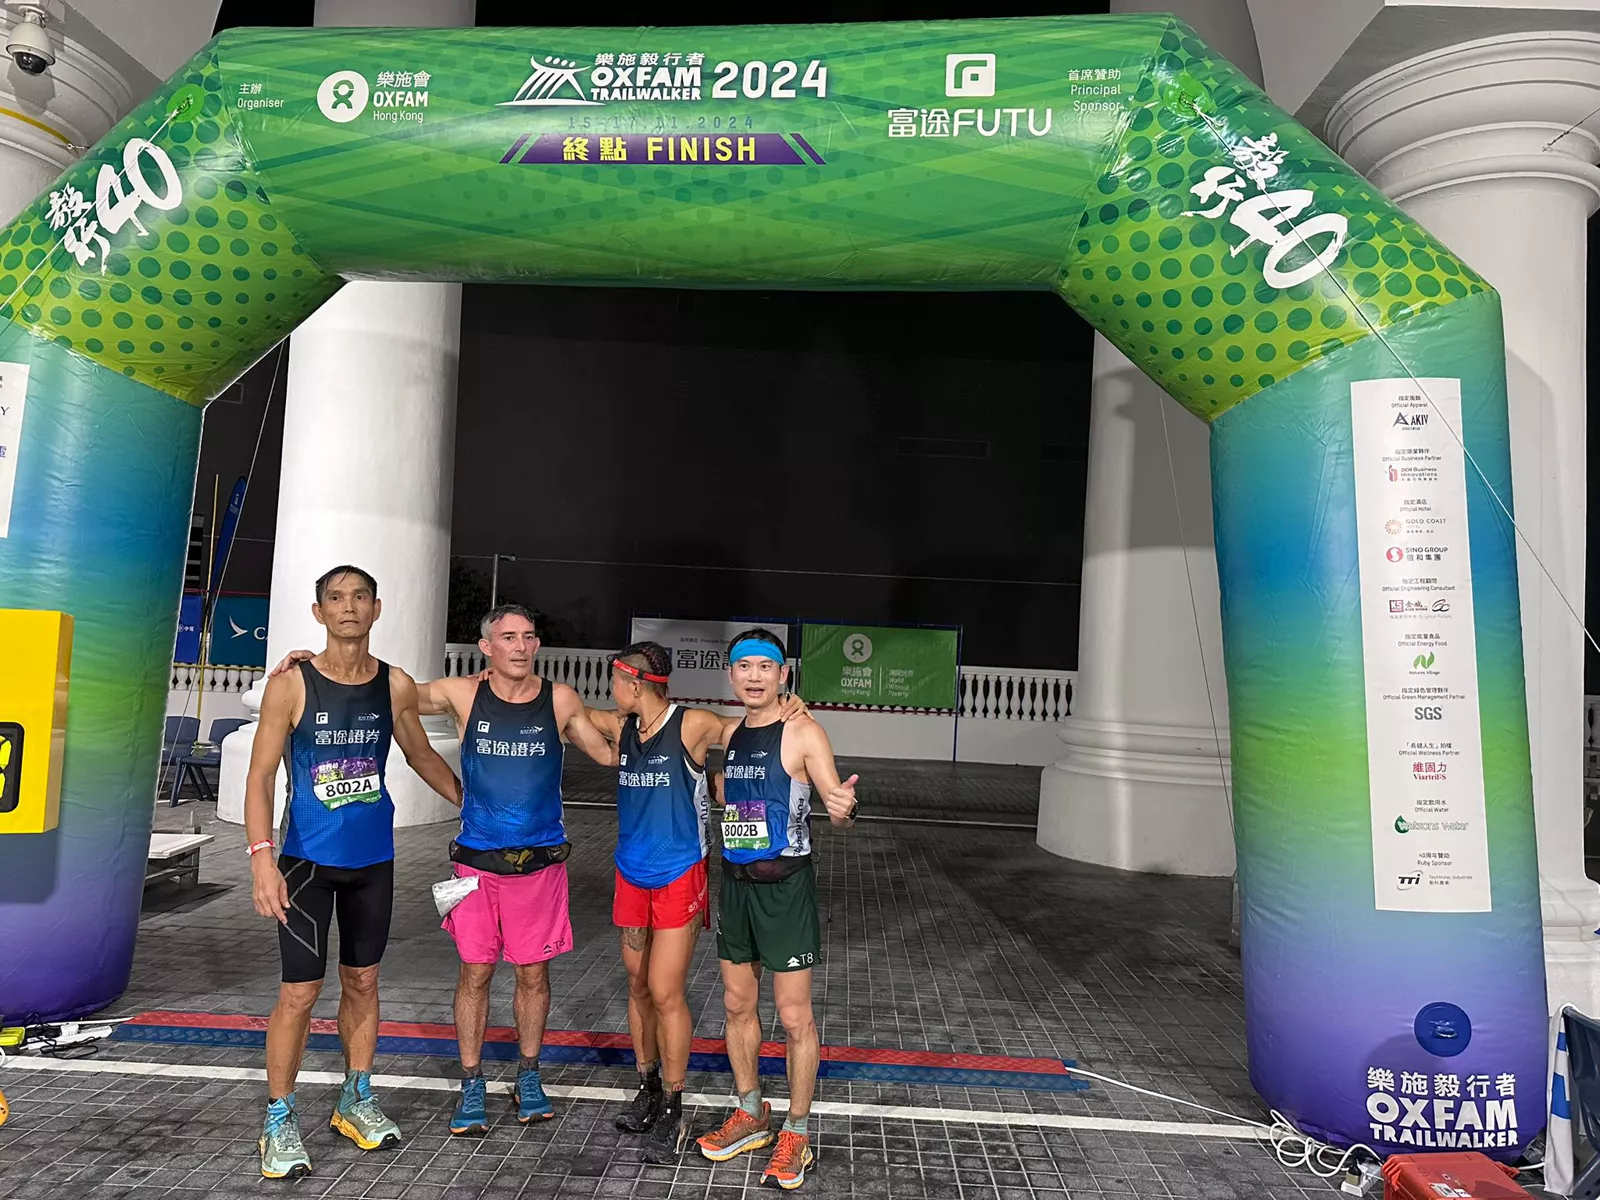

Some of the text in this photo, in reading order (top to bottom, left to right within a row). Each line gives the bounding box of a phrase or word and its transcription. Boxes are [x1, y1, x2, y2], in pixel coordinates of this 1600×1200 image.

[595, 53, 705, 66] 樂施毅行者
[376, 70, 431, 88] 樂施會
[590, 67, 702, 87] OXFAM
[711, 60, 828, 99] 2024
[1067, 68, 1121, 81] 首席贊助
[239, 83, 262, 95] 主辦
[590, 88, 702, 101] TRAILWALKER
[1070, 84, 1121, 96] Principal
[237, 97, 284, 111] Organiser
[373, 91, 428, 107] OXFAM
[1073, 100, 1121, 113] Sponsor
[373, 110, 424, 123] Hong Kong
[562, 137, 755, 161] 終點 FINISH
[95, 137, 183, 235] 40
[1230, 189, 1349, 290] 40
[841, 678, 872, 688] OXFAM
[1414, 706, 1442, 721] SGS
[326, 779, 372, 797] 8002A
[724, 824, 758, 837] 8002B
[800, 952, 814, 965] T8
[1366, 1066, 1516, 1098] 樂施毅行者
[1366, 1092, 1519, 1131] OXFAM
[1369, 1122, 1519, 1149] TRAILWALKER
